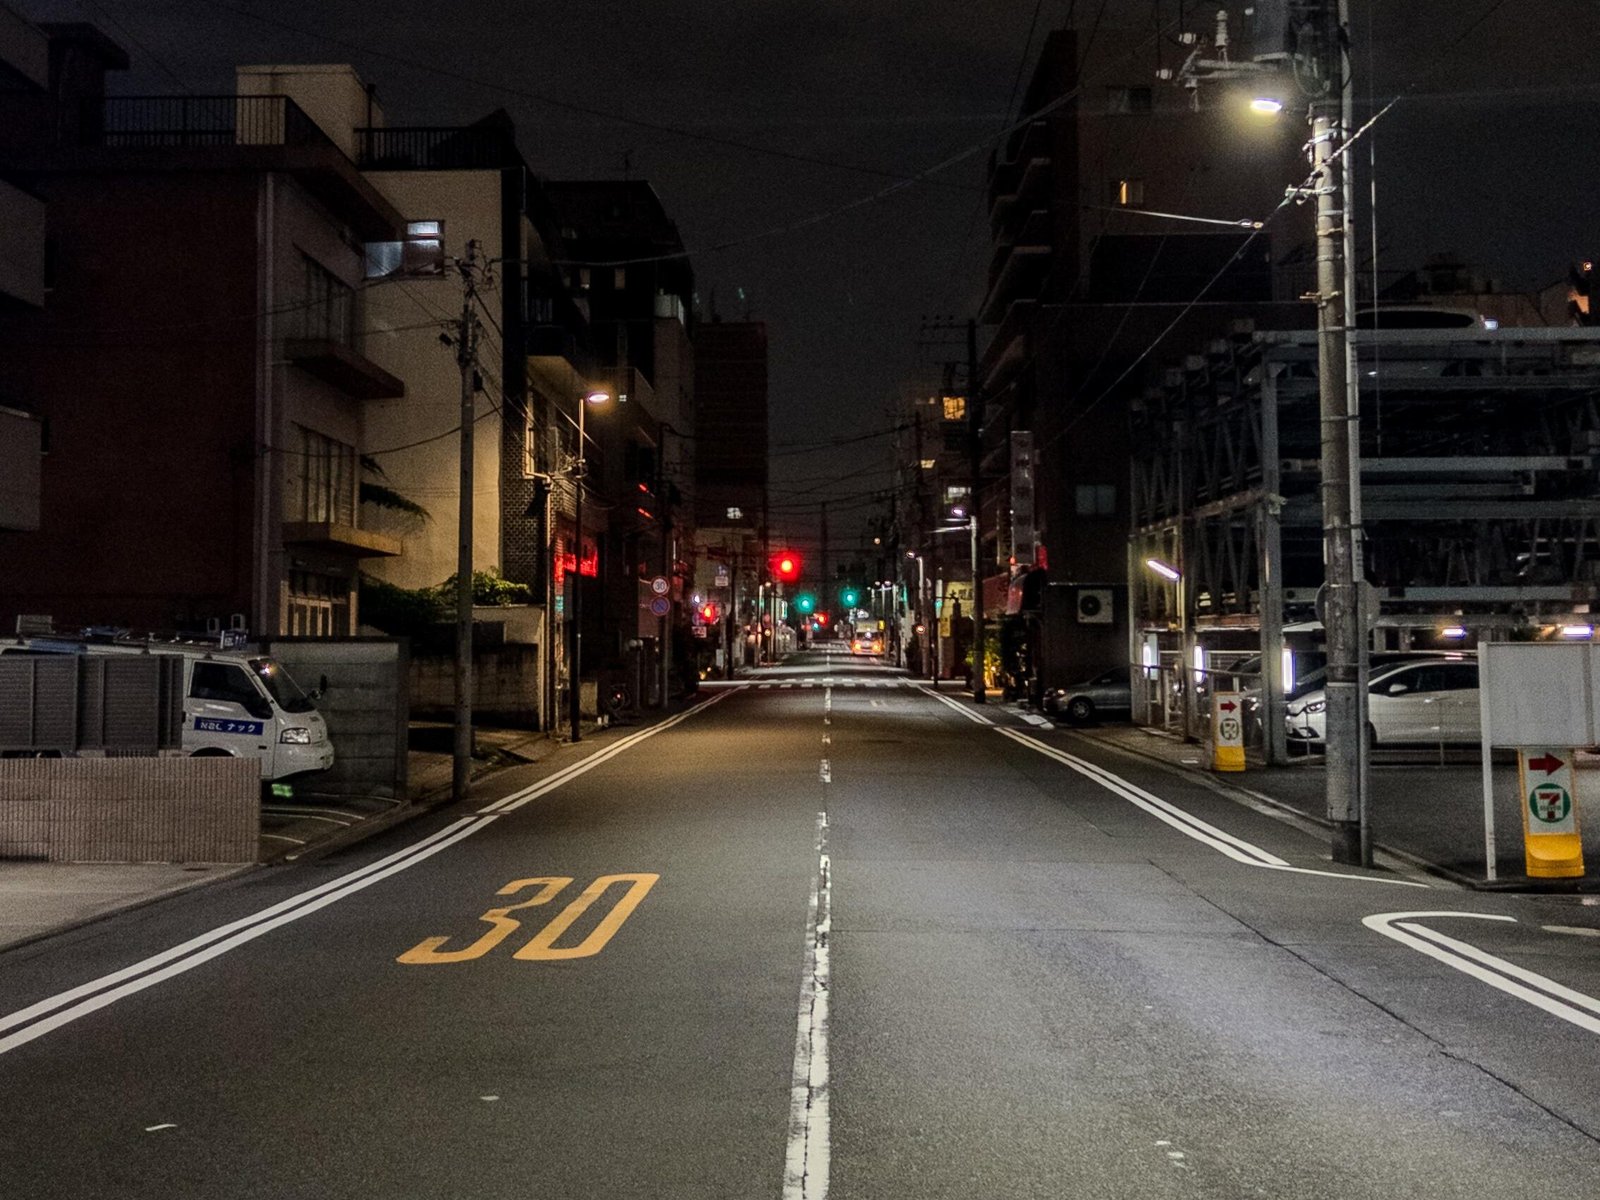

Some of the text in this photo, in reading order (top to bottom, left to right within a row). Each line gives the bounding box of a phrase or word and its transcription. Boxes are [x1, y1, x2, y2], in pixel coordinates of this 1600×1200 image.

[655, 581, 665, 591] 30
[227, 723, 255, 733] ナック
[396, 873, 660, 964] 30
